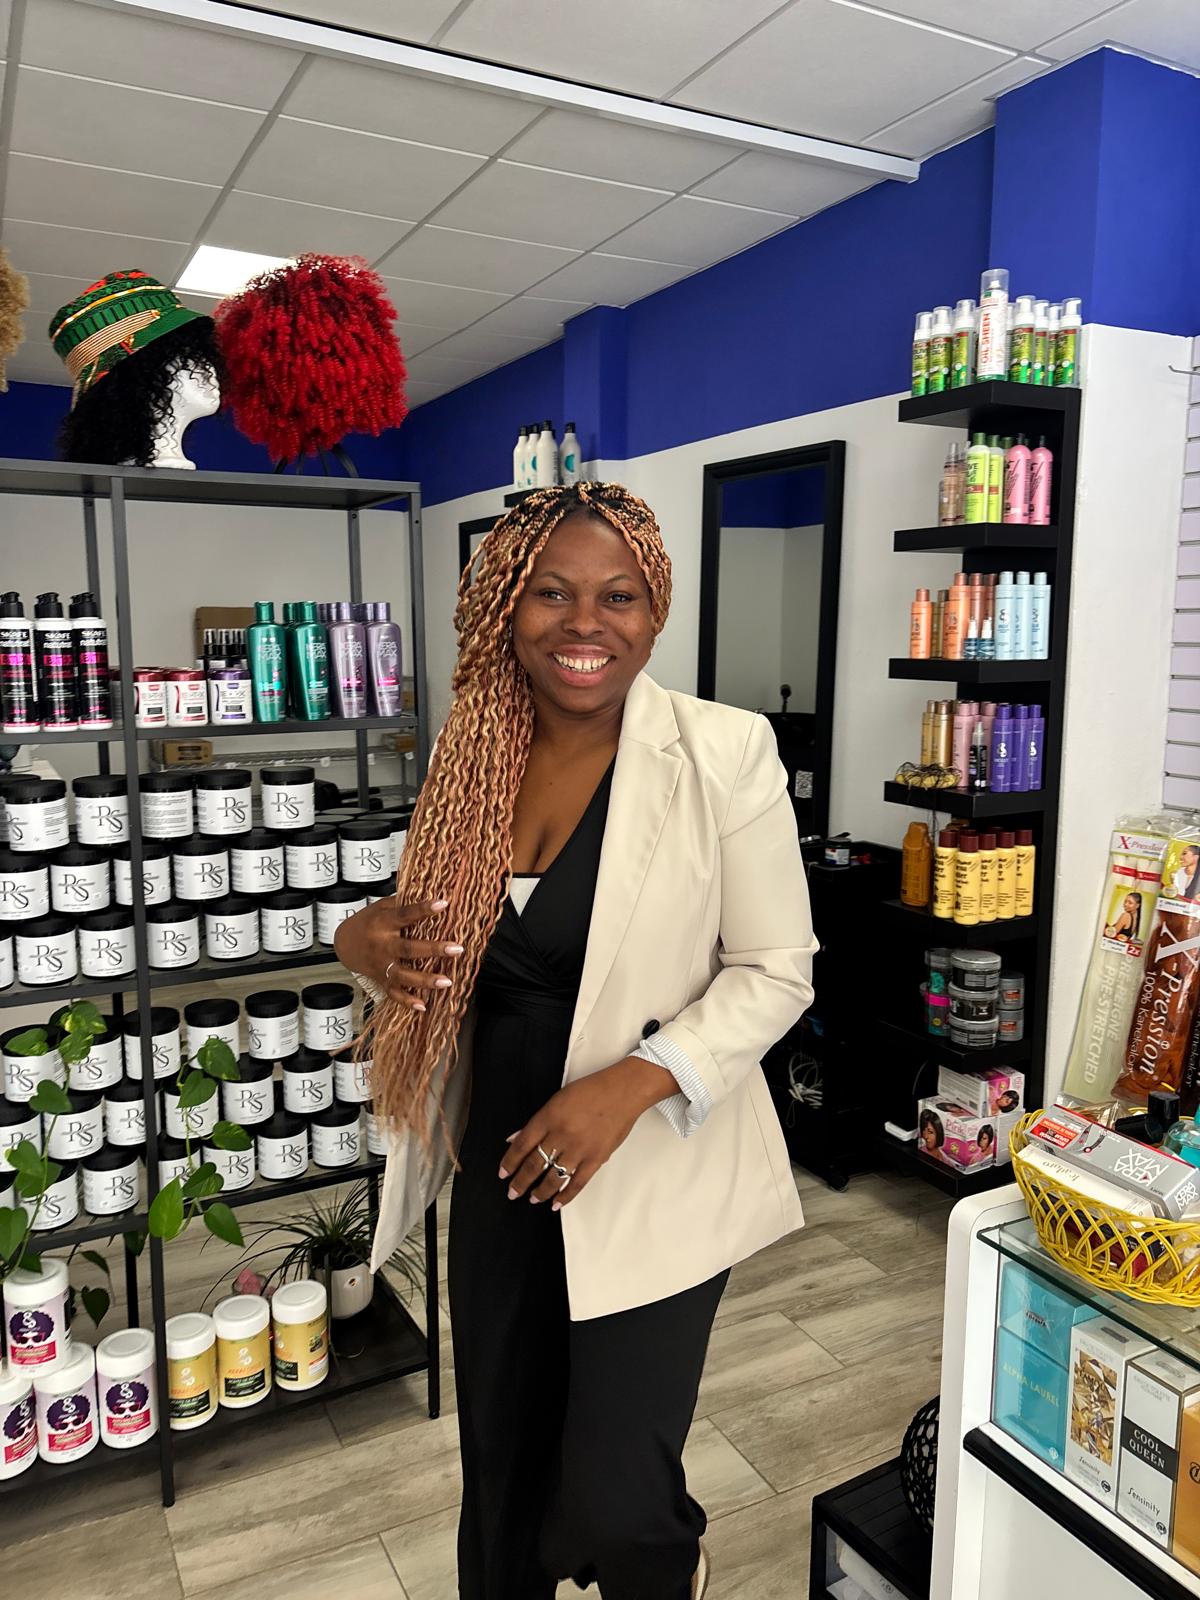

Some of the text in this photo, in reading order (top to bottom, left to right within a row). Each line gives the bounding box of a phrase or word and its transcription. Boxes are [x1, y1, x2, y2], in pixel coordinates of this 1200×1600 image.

[981, 312, 991, 364] OIL SHEEN
[224, 797, 246, 823] RS
[276, 792, 300, 819] RS
[8, 811, 24, 841] S
[97, 806, 122, 833] RS
[260, 856, 280, 881] RS
[314, 852, 335, 876] RS
[360, 847, 382, 872] RS
[64, 874, 89, 901] RS
[142, 873, 155, 895] S
[201, 862, 223, 888] RS
[3, 881, 29, 909] RS
[215, 922, 238, 949] RS
[285, 916, 306, 941] RS
[97, 939, 122, 966] RS
[163, 930, 187, 956] RS
[36, 945, 62, 972] RS
[1141, 971, 1156, 1004] 100%
[326, 1016, 346, 1039] RS
[1084, 966, 1116, 1084] PRE-STRETCHED
[10, 1064, 33, 1091] RS
[241, 1090, 262, 1113] RS
[302, 1080, 323, 1102] RS
[69, 1122, 93, 1146] RS
[340, 1132, 357, 1154] RS
[228, 1155, 249, 1177] RS
[282, 1144, 302, 1167] RS
[1124, 1148, 1169, 1181] MAX
[1113, 1155, 1158, 1188] KERA
[112, 1176, 133, 1199] RS
[1129, 1438, 1166, 1470] QUEEN
[1133, 1429, 1162, 1454] COOL
[1127, 1487, 1161, 1516] Sensinity
